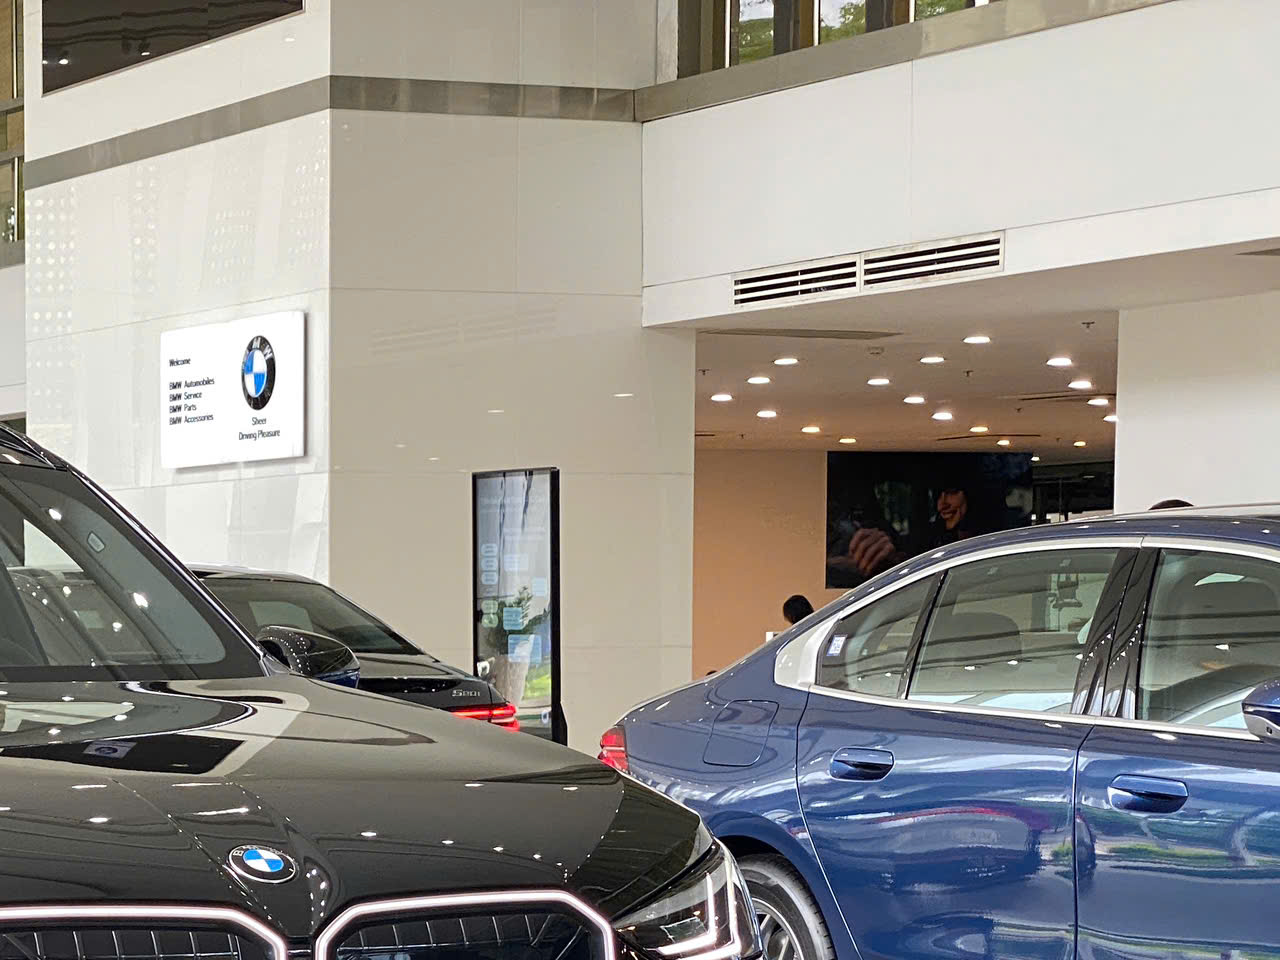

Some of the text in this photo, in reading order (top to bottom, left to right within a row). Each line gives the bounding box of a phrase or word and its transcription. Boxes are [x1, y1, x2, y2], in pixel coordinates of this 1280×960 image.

[169, 357, 191, 367] Welcome
[169, 377, 215, 391] BMW Automobiles
[169, 392, 202, 402] BMW Service
[169, 404, 197, 413] BMW Parts
[169, 413, 213, 425] BMW Accessories
[252, 417, 267, 425] Sheer
[239, 429, 280, 441] Driving Pleasure
